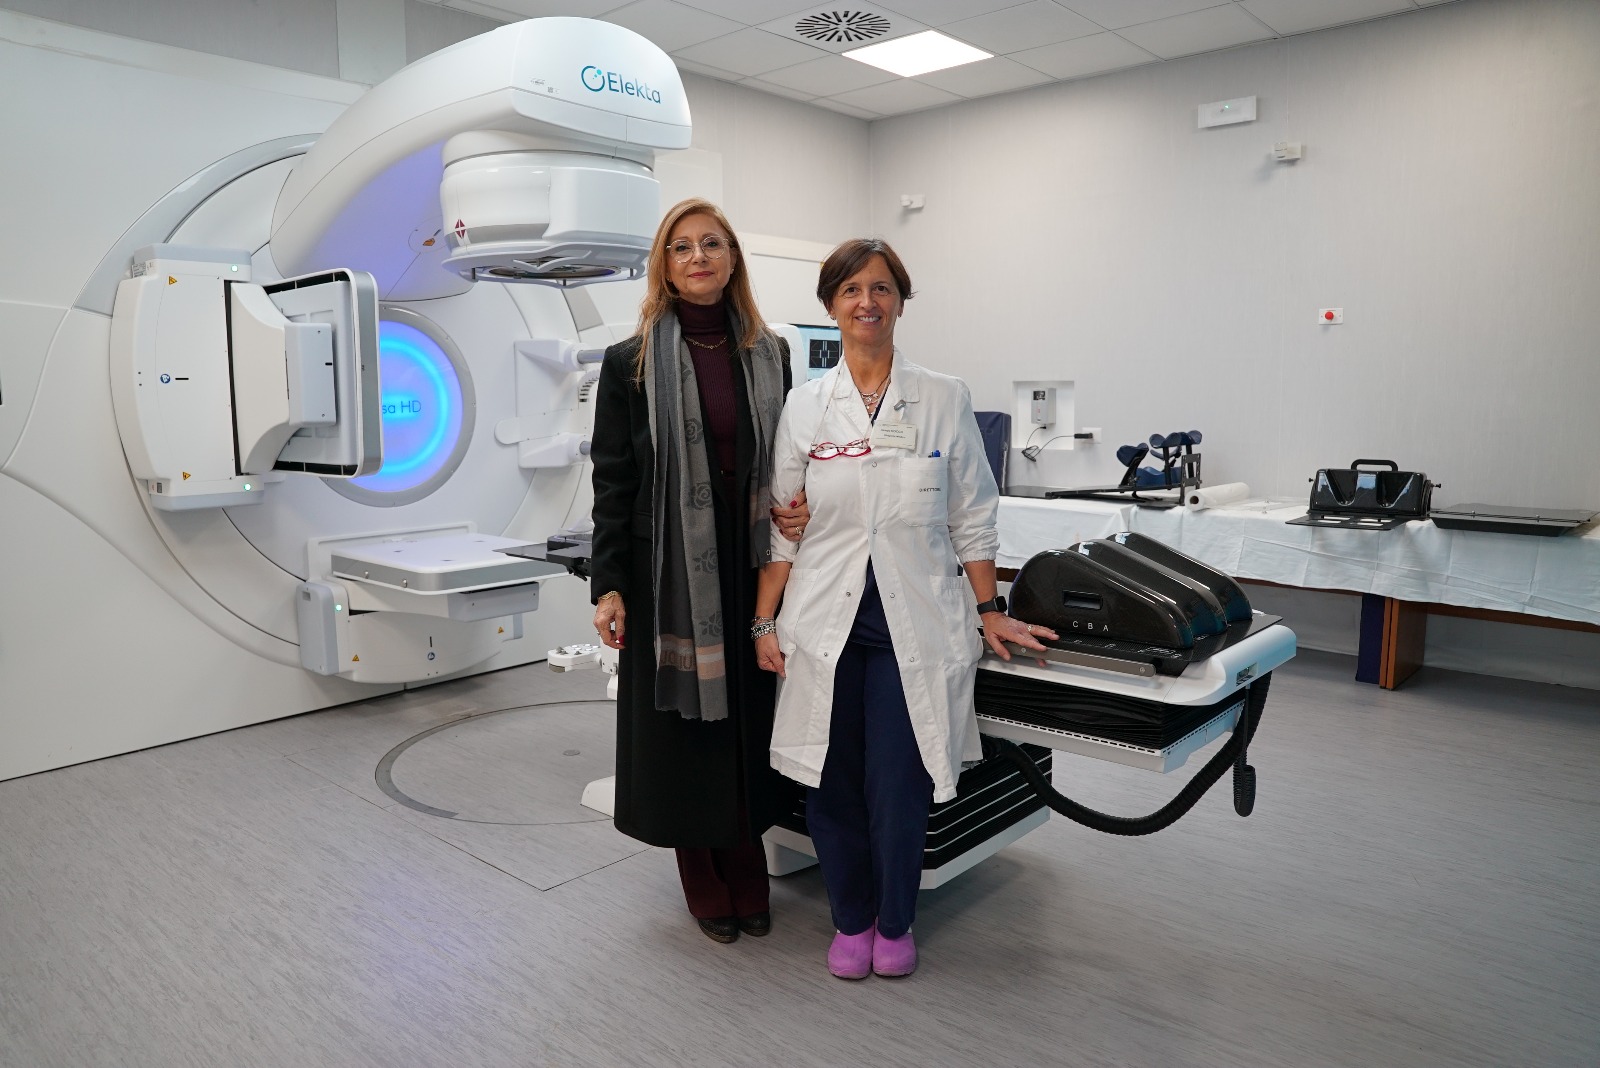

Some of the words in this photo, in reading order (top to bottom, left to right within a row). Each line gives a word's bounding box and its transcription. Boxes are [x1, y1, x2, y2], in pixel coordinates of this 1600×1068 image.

[606, 71, 662, 104] Elekta
[400, 400, 422, 413] HD
[1072, 620, 1079, 628] C
[1087, 622, 1094, 630] B
[1102, 624, 1109, 632] A
